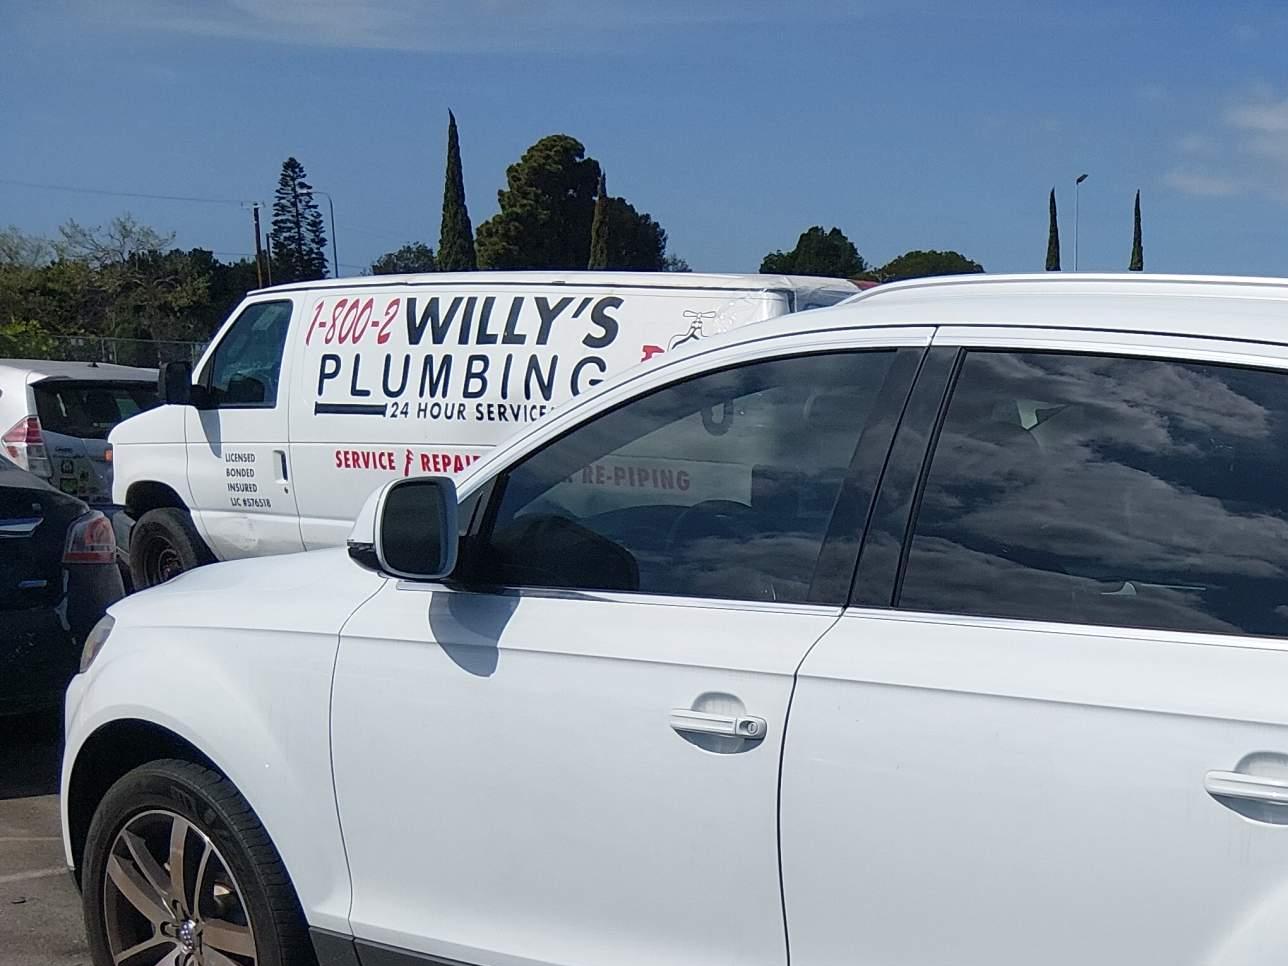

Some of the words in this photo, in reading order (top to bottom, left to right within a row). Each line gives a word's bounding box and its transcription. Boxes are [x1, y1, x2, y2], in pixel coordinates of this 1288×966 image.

[317, 353, 607, 401] PLUMBING
[390, 402, 410, 419] 24
[416, 402, 467, 421] HOUR
[225, 452, 256, 463] LICENSED
[226, 468, 255, 478] BONDED
[335, 450, 396, 471] SERVICE
[582, 464, 691, 492] RE-PIPING
[227, 482, 258, 493] INSURED
[230, 497, 242, 507] LIC
